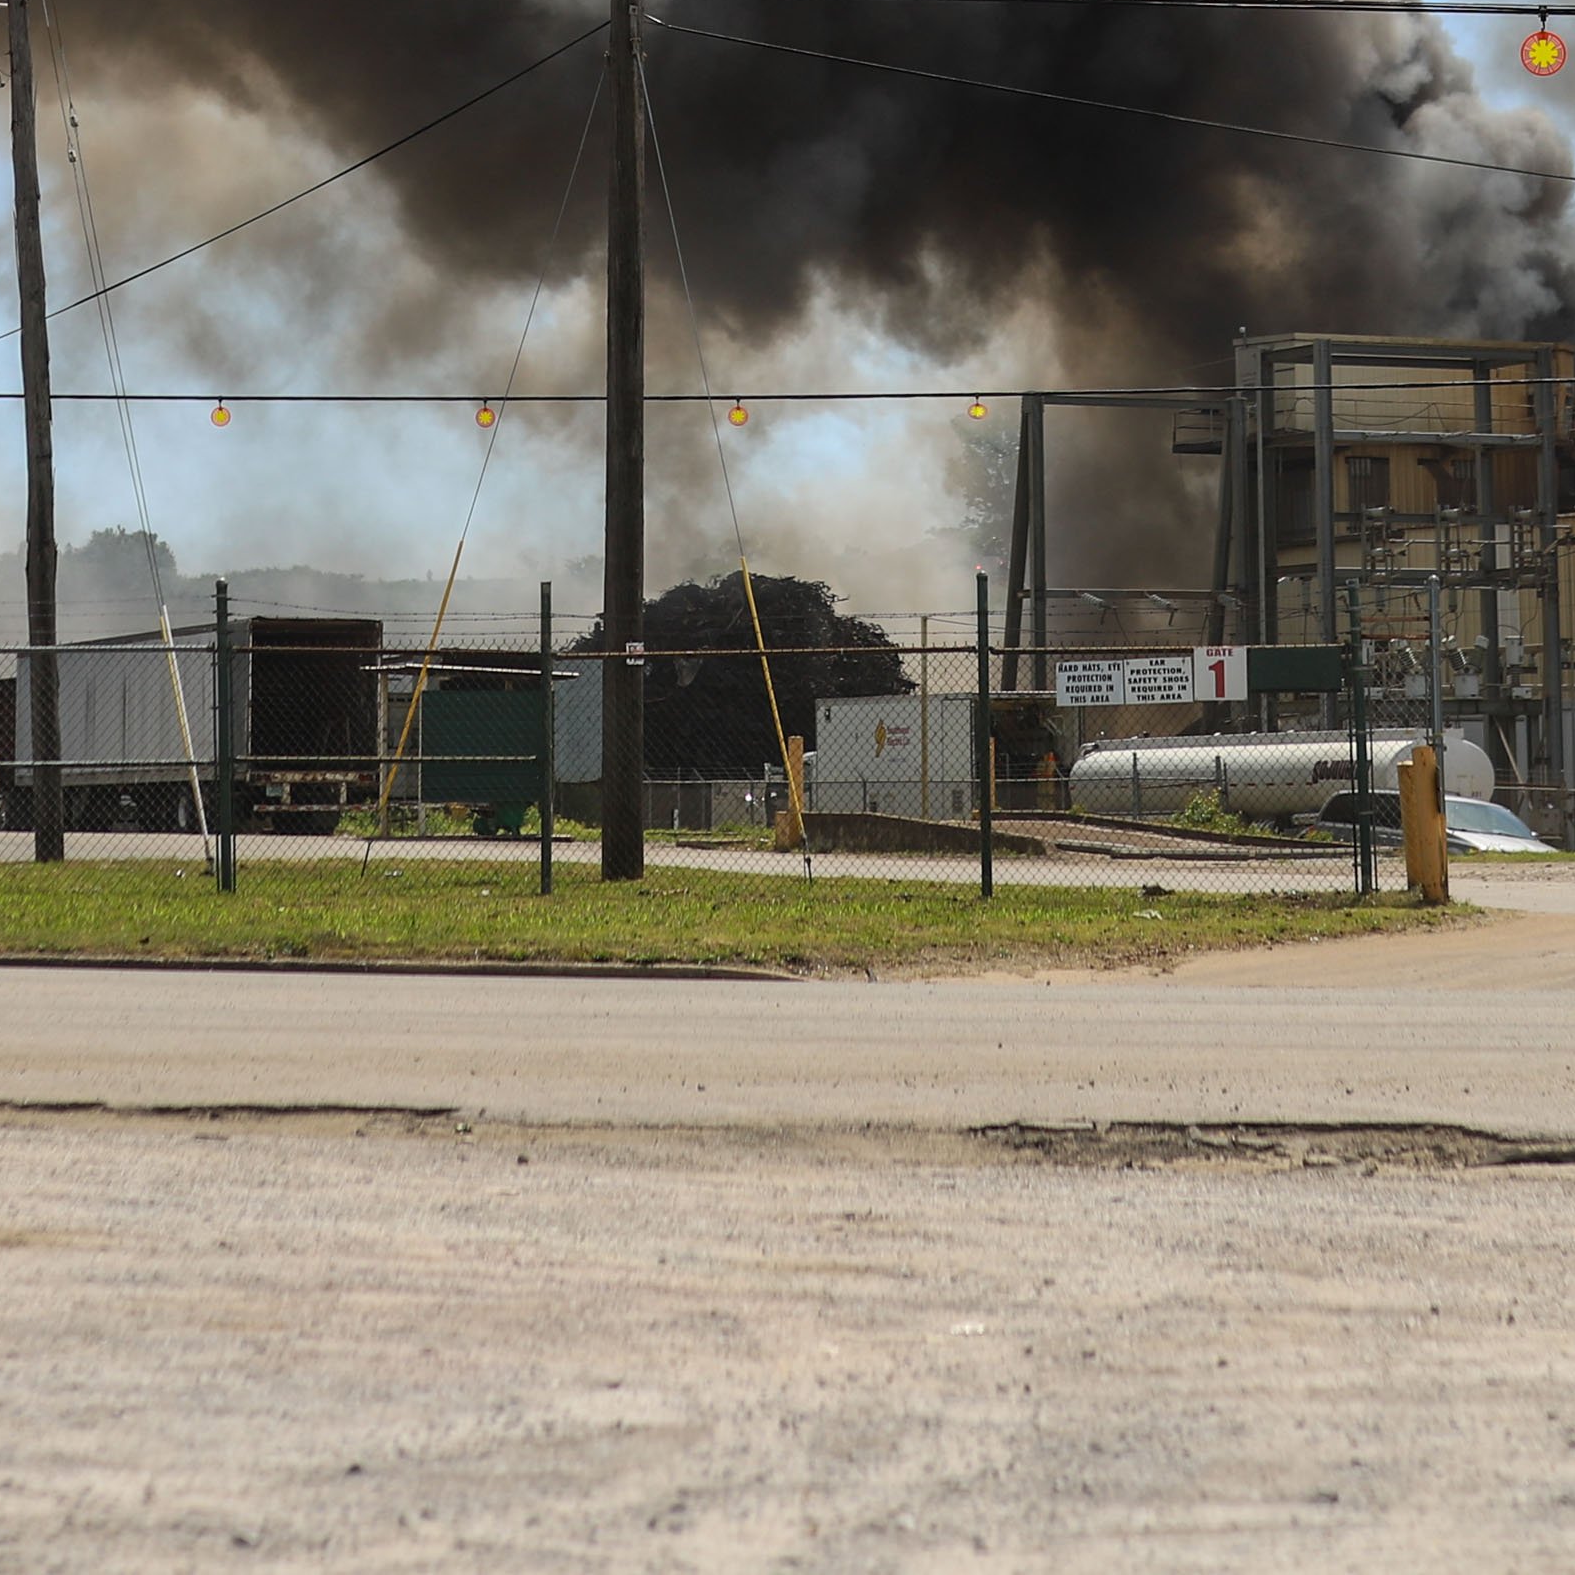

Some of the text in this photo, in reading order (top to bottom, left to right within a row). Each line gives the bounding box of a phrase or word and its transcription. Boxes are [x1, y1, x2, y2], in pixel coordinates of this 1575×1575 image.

[1206, 648, 1234, 657] GATE
[1058, 663, 1079, 673] HARD
[1107, 662, 1122, 672] EYE
[1149, 659, 1166, 667] EAR
[1066, 673, 1113, 683] PROTECTION
[1127, 675, 1190, 685] SAFETY SHOES
[1208, 659, 1226, 698] 1
[1065, 684, 1115, 694] REQUIRED IN
[1130, 683, 1188, 693] REQUIRED IN
[1070, 694, 1110, 704] THIS AREA
[1136, 692, 1183, 702] THIS AREA
